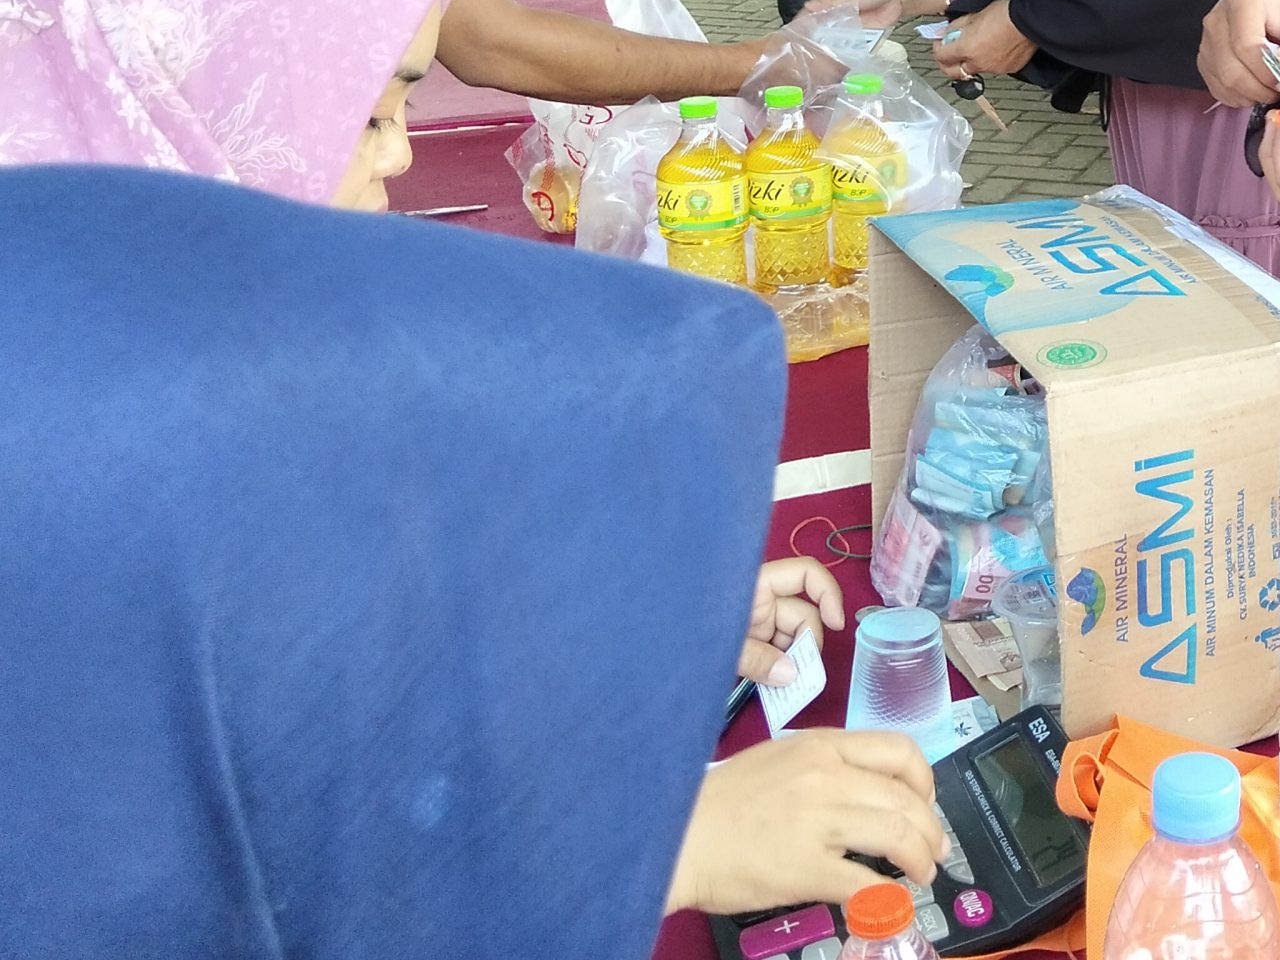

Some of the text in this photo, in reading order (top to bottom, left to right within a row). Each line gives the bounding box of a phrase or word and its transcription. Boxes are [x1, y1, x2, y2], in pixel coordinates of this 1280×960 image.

[1007, 212, 1188, 296] ASMI
[1040, 275, 1073, 290] AIR
[1134, 449, 1197, 685] ASMI
[1203, 469, 1216, 657] AIR MINUM DALAM KEMASAN
[1225, 547, 1234, 599] Diproduksi
[1236, 488, 1248, 620] CV. SURYA NEDIKA ISABELLA
[1247, 523, 1256, 578] INDONESIA
[1114, 533, 1129, 643] AIR MINERAL
[1028, 717, 1051, 743] ESA
[969, 778, 983, 796] STEPS
[977, 794, 991, 813] CHECK
[988, 814, 1005, 839] CORRECT
[1000, 837, 1022, 873] CALCULATOR
[920, 908, 938, 932] CHECK
[959, 891, 985, 918] ON/AC
